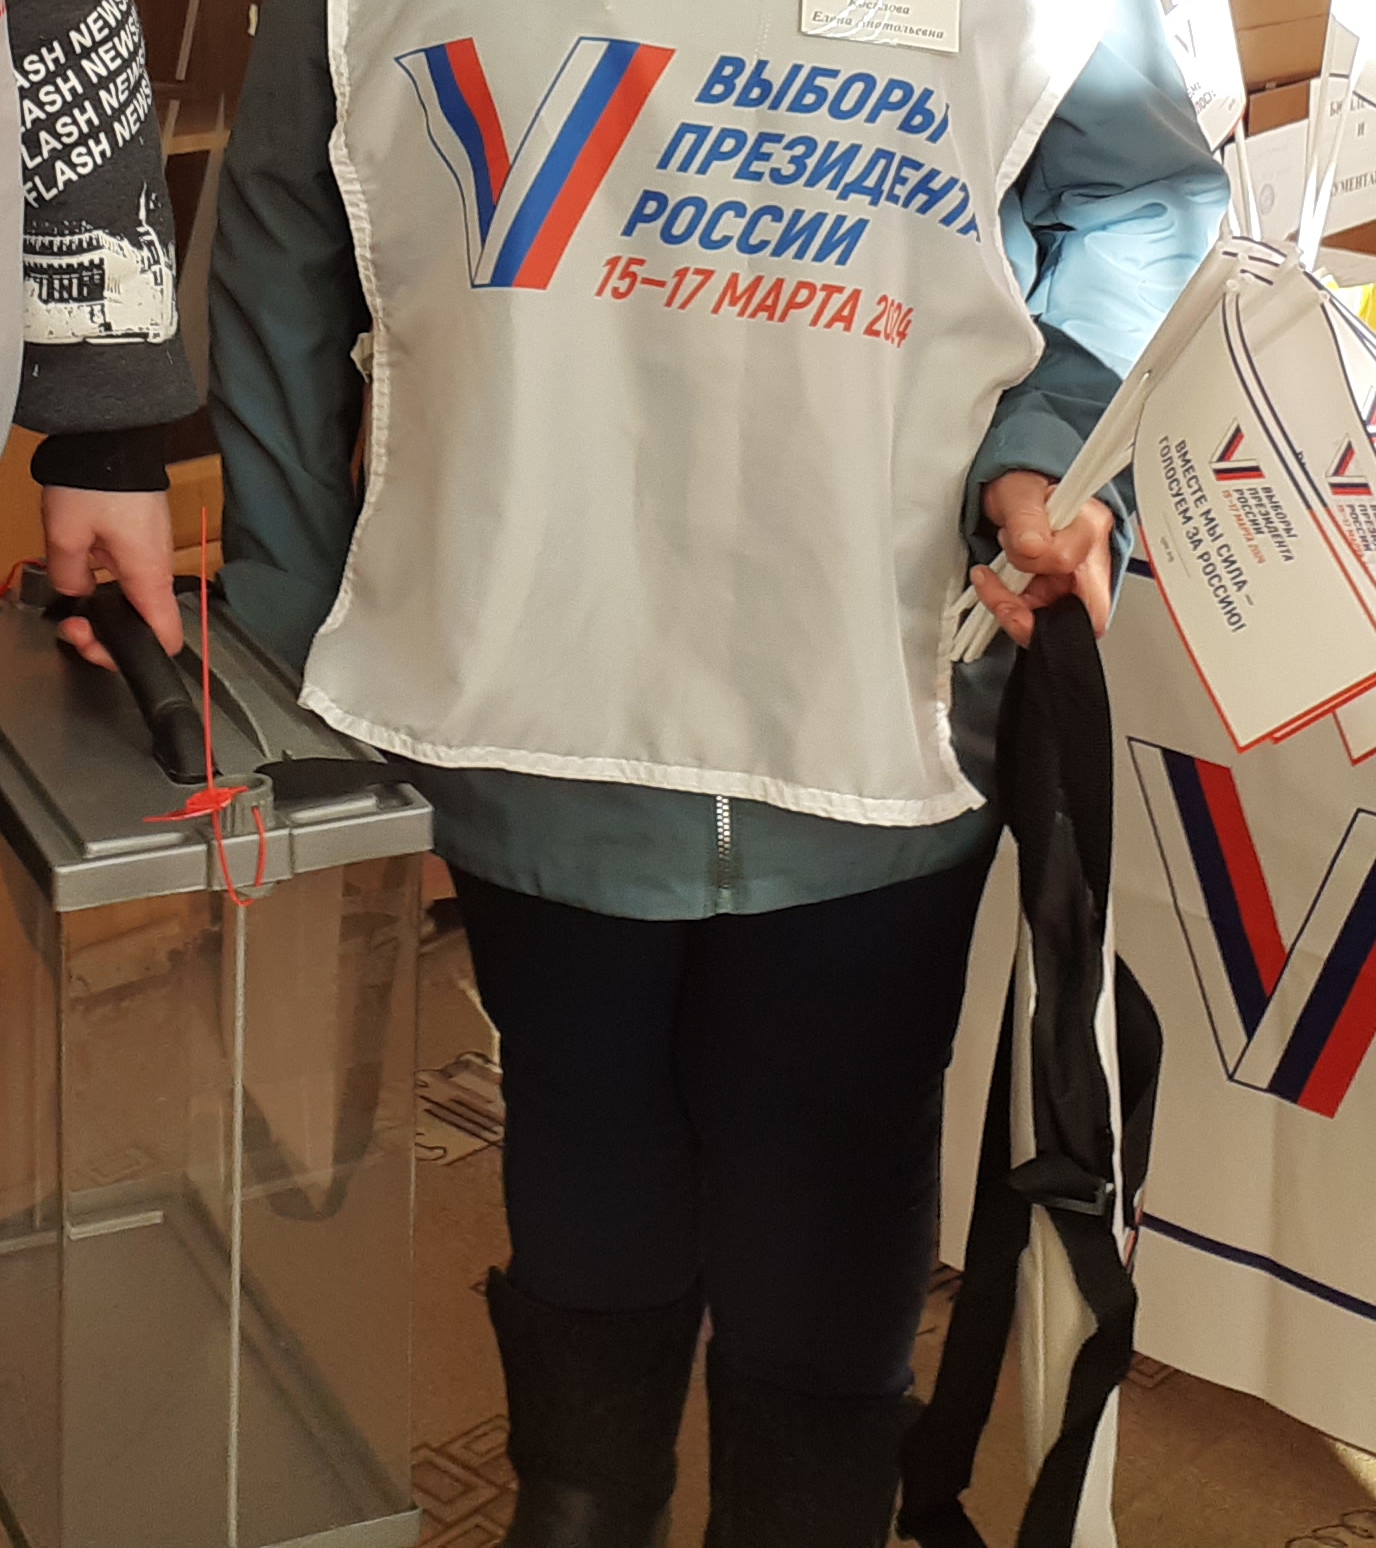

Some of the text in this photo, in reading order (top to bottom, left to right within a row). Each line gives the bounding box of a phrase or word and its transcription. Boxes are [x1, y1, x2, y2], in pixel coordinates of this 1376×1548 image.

[694, 53, 952, 145] ВЫБОРЫ
[24, 132, 112, 209] FLASH
[656, 121, 982, 243] ПРЕЗИДЕНТА
[620, 188, 870, 266] РОССИИ
[712, 271, 863, 333] МАРТА
[863, 294, 913, 349] 2024
[1158, 435, 1248, 634] ГОЛОСУЕМ ЗА РОССИЮ!
[1174, 439, 1209, 509] ВМЕСТЕ
[1199, 508, 1226, 543] МЫ
[1216, 543, 1249, 594] СИЛА
[1232, 488, 1268, 536] РОССИИ
[1246, 487, 1295, 563] ПРЕЗИДЕНТА
[1261, 486, 1299, 540] ВЫБОРЫ
[1346, 504, 1373, 552] РОССИИ
